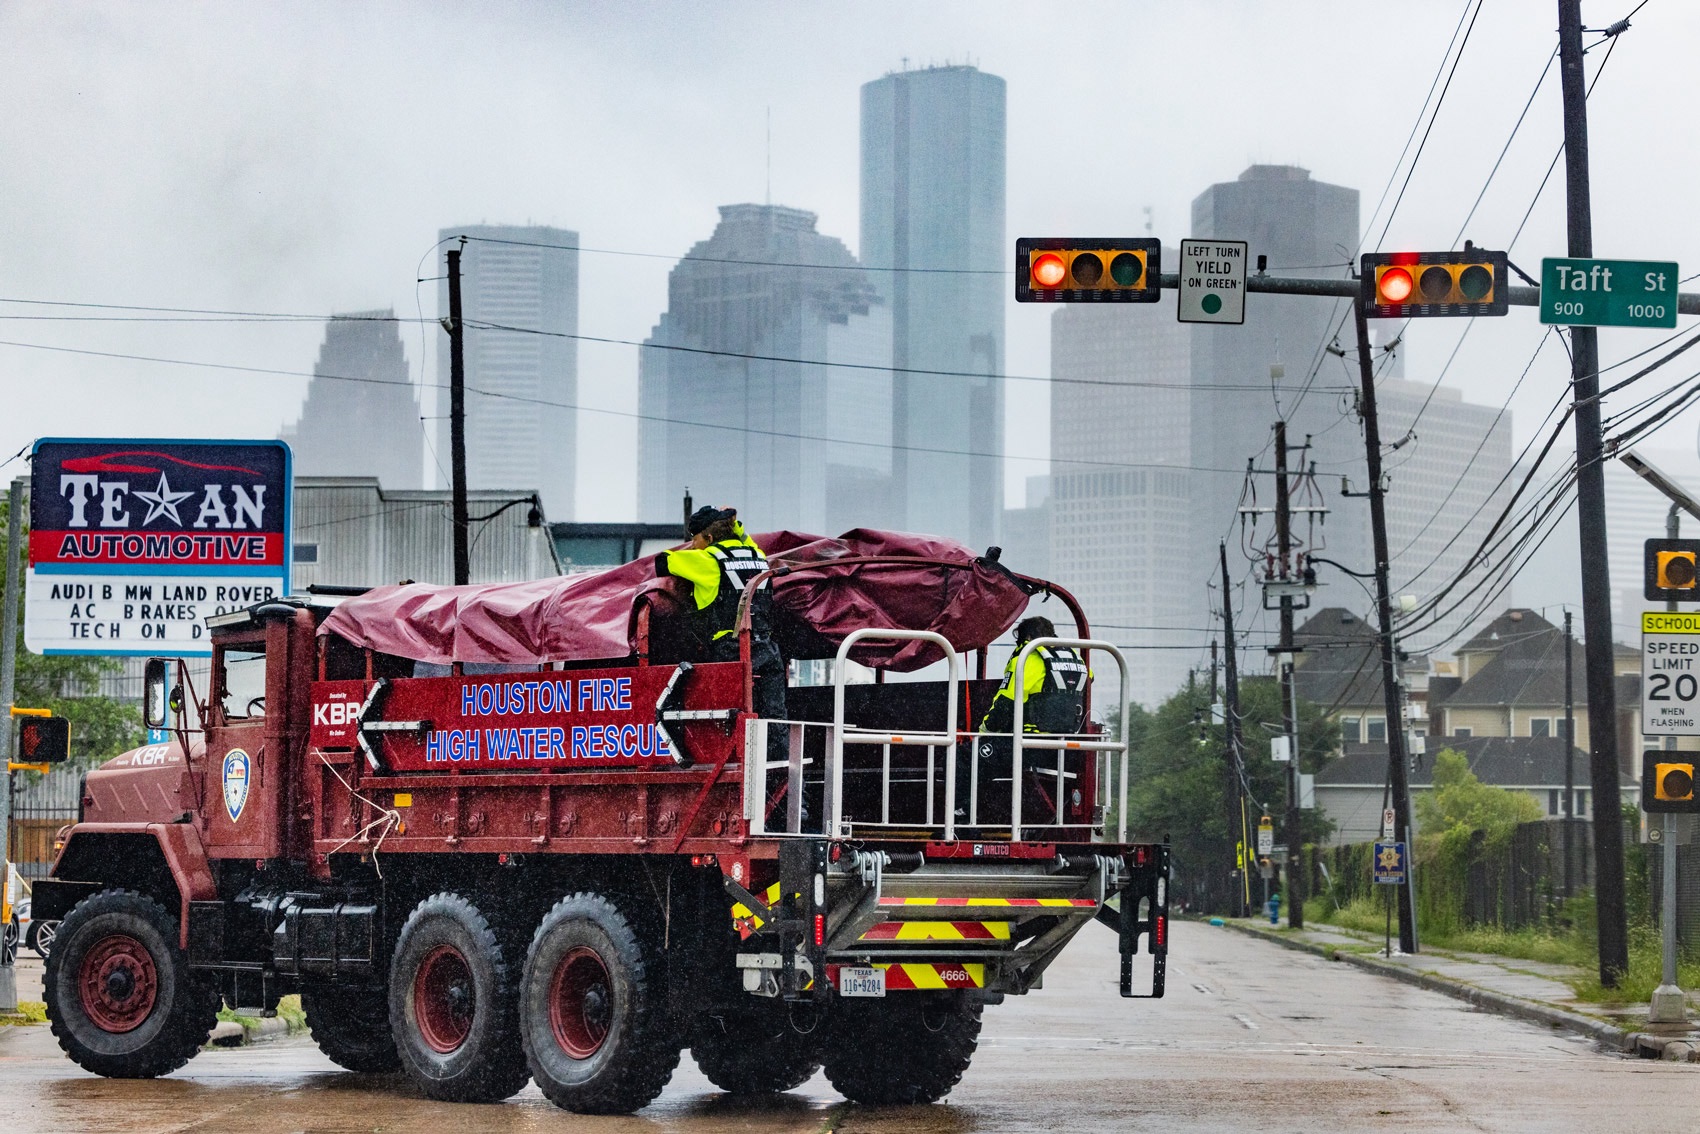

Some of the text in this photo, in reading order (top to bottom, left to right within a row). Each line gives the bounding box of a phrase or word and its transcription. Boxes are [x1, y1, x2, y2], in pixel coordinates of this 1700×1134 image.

[1188, 246, 1240, 257] LEFT TURN
[1196, 261, 1231, 274] YIELD
[1188, 278, 1237, 289] ON GREEN
[1556, 265, 1666, 292] Taft St
[1554, 302, 1665, 319] 900 1000
[57, 534, 266, 560] AUTOMOTIVE
[724, 561, 756, 570] HOUSTON
[51, 584, 93, 600] AUDI
[163, 586, 207, 601] LAND
[216, 586, 274, 601] ROVER
[1646, 618, 1700, 630] SCHOOL
[71, 623, 120, 638] TECH
[141, 623, 166, 638] ON
[1647, 642, 1699, 654] SPEED
[1653, 658, 1693, 670] LIMIT
[1648, 674, 1698, 701] 20
[461, 677, 632, 716] HOUSTON FIRE
[1661, 708, 1685, 716] WHEN
[1651, 719, 1694, 727] FLASHING
[426, 730, 480, 762] HIGH
[486, 727, 566, 761] WATER
[131, 746, 169, 766] KBR
[983, 845, 1009, 855] WALTCO
[940, 970, 969, 981] 46661
